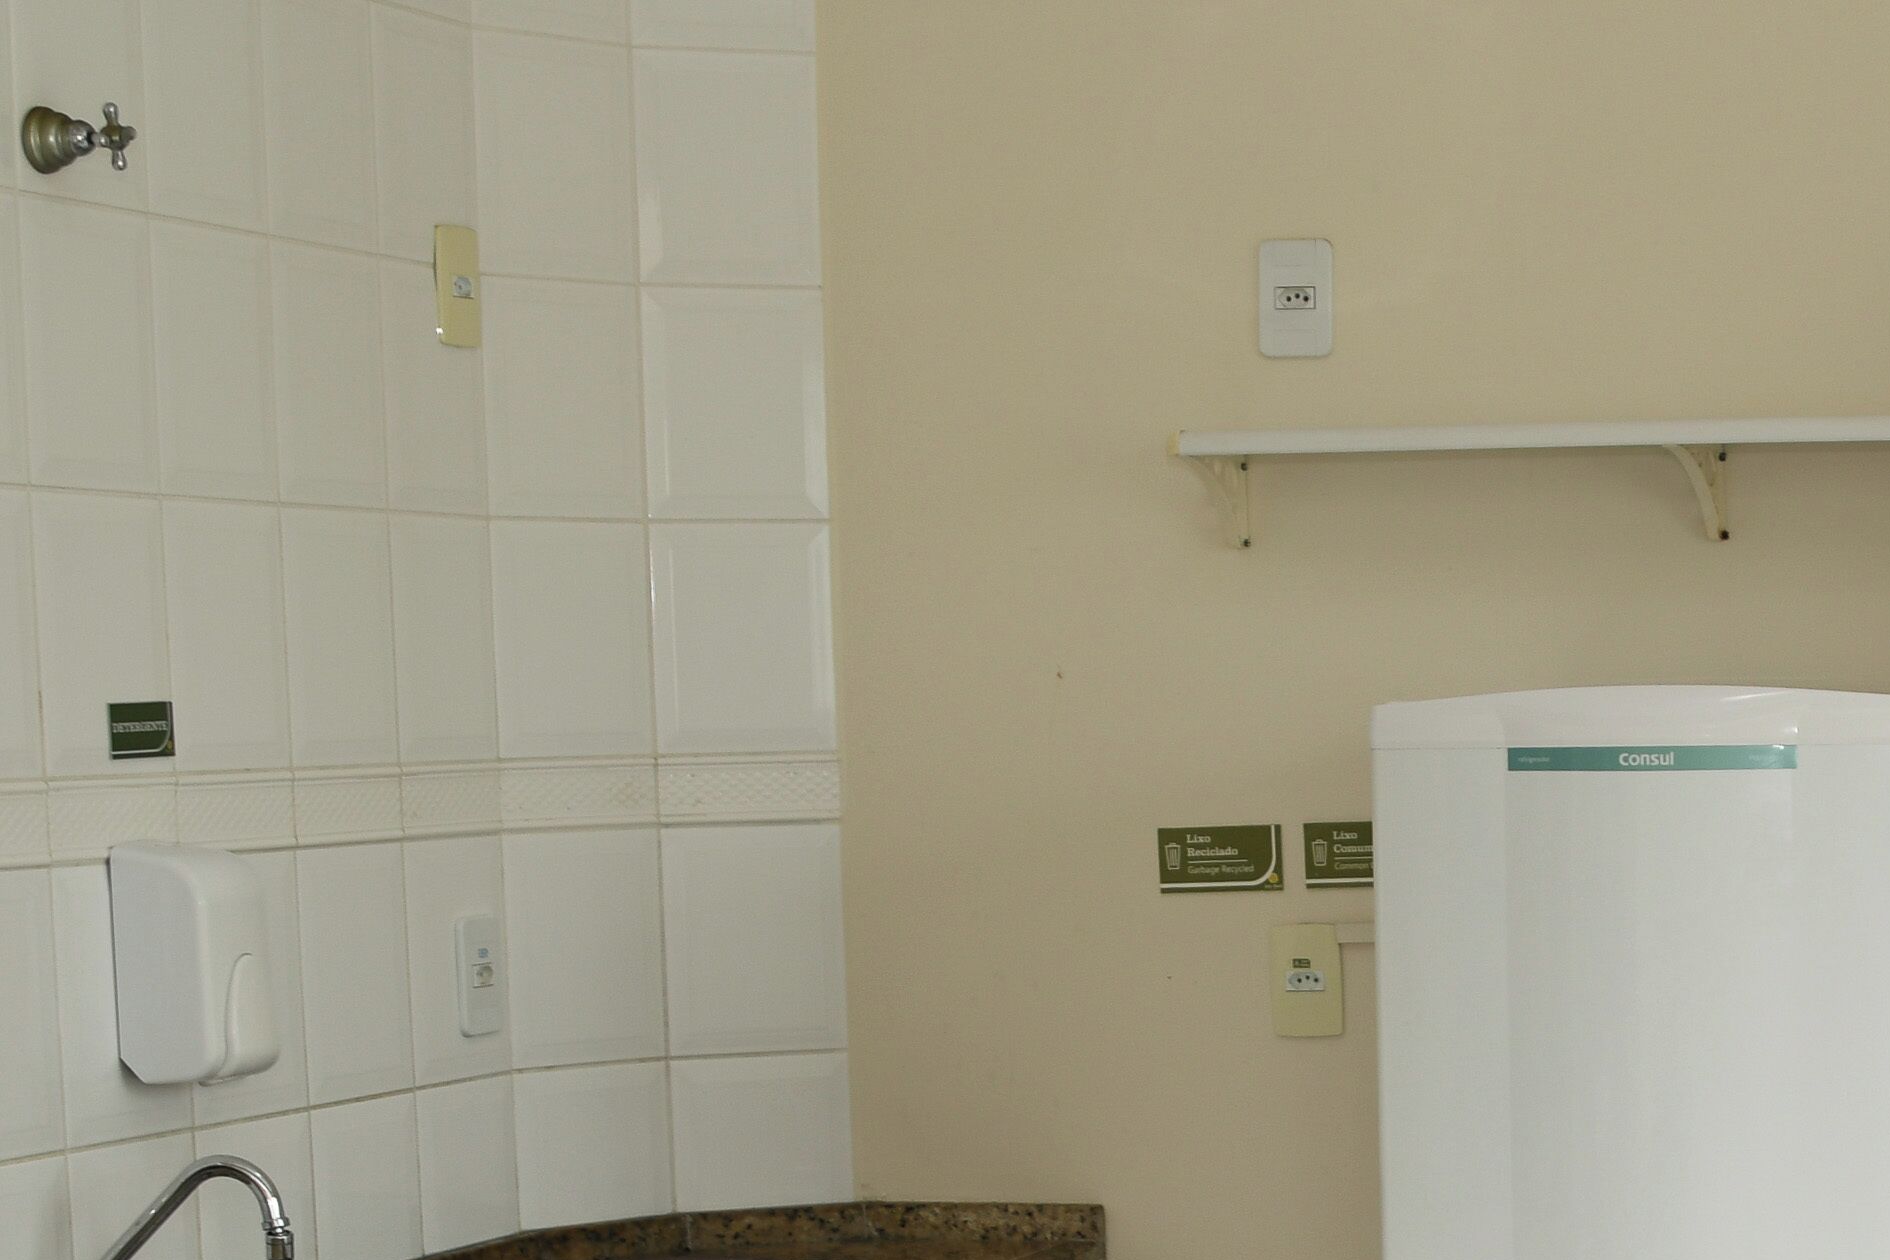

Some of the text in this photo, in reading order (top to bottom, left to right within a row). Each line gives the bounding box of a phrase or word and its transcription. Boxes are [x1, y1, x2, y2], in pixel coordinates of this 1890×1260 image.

[1186, 833, 1212, 844] Lixo
[1332, 830, 1358, 840] Lixo
[1186, 847, 1239, 857] Reciclado
[1187, 863, 1255, 875] Garbage Recycled
